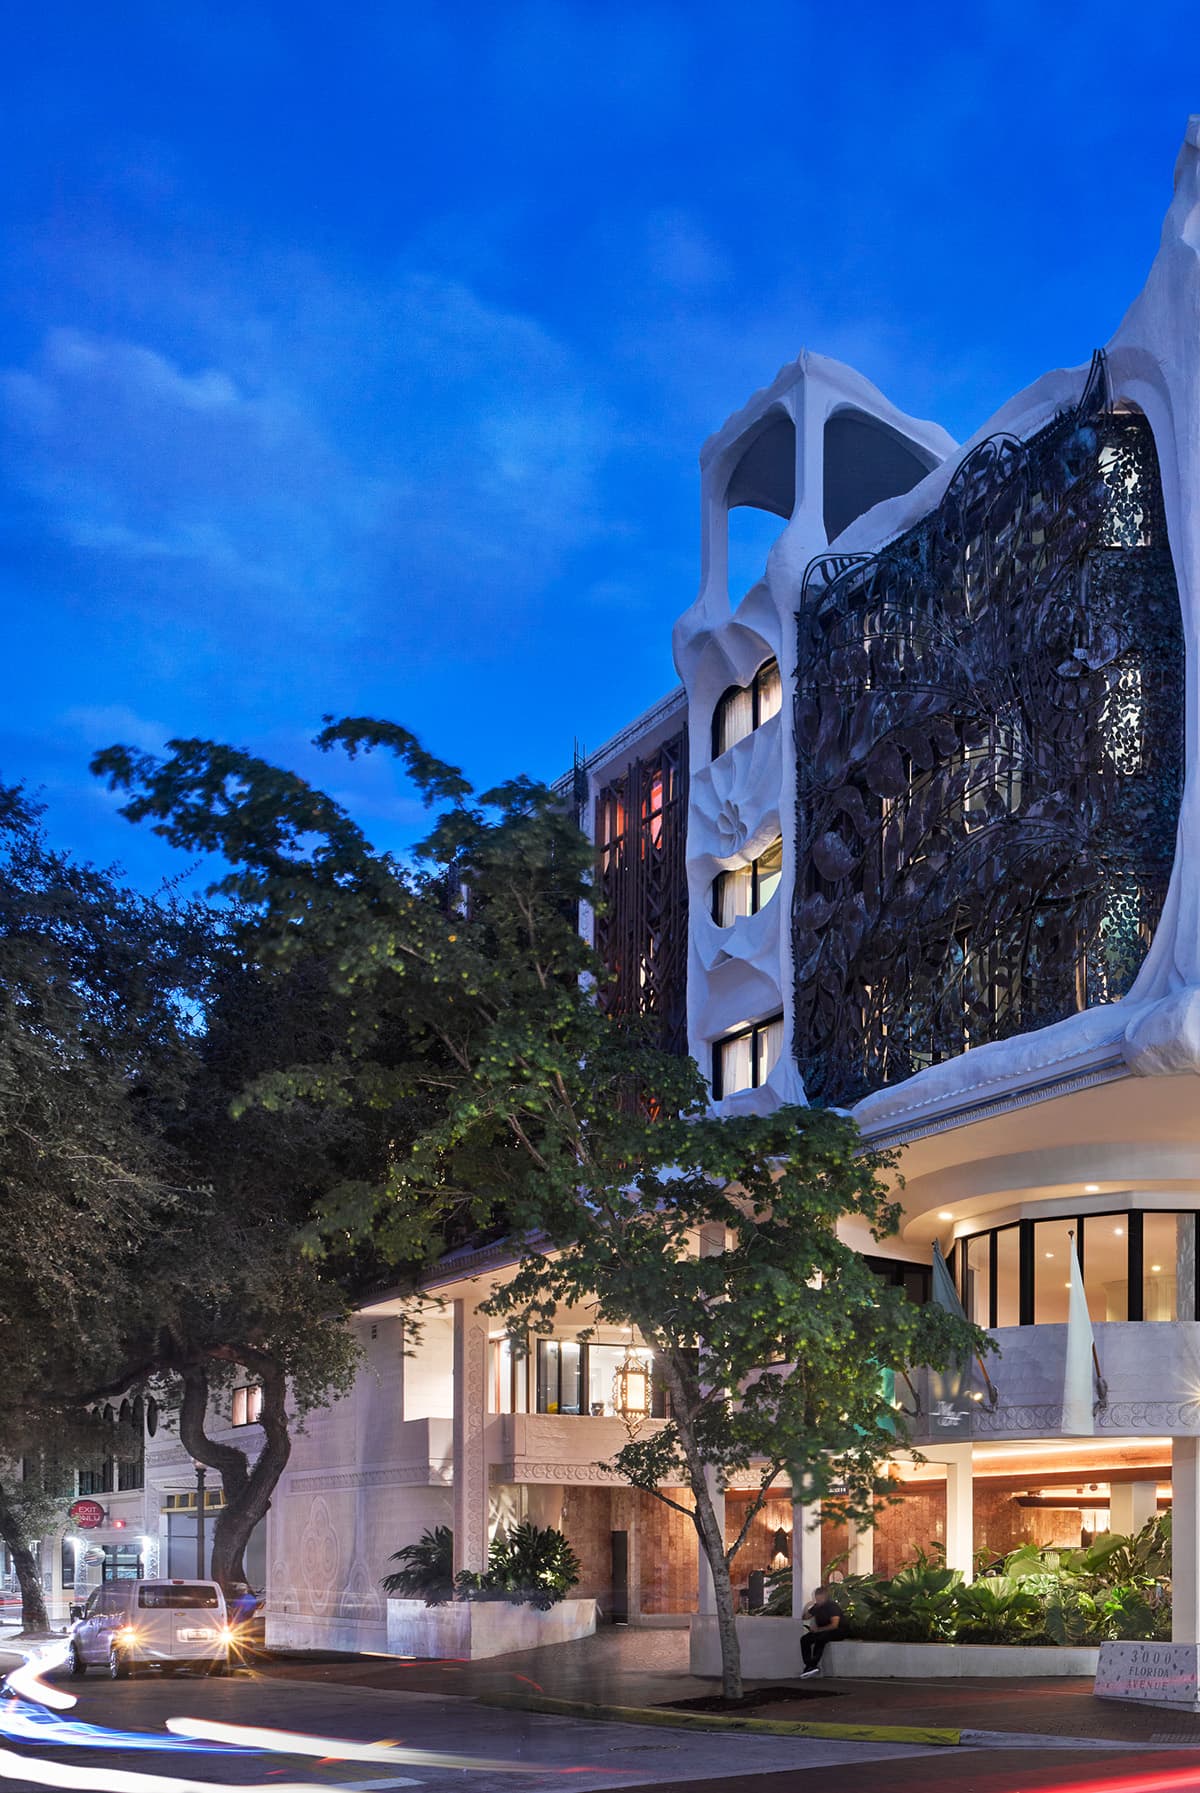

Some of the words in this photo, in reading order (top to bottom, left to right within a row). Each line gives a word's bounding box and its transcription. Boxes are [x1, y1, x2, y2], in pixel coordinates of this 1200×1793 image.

[1130, 1649, 1171, 1665] 3000
[1128, 1665, 1169, 1678] FLORIDA
[1127, 1679, 1169, 1691] AVENUE
